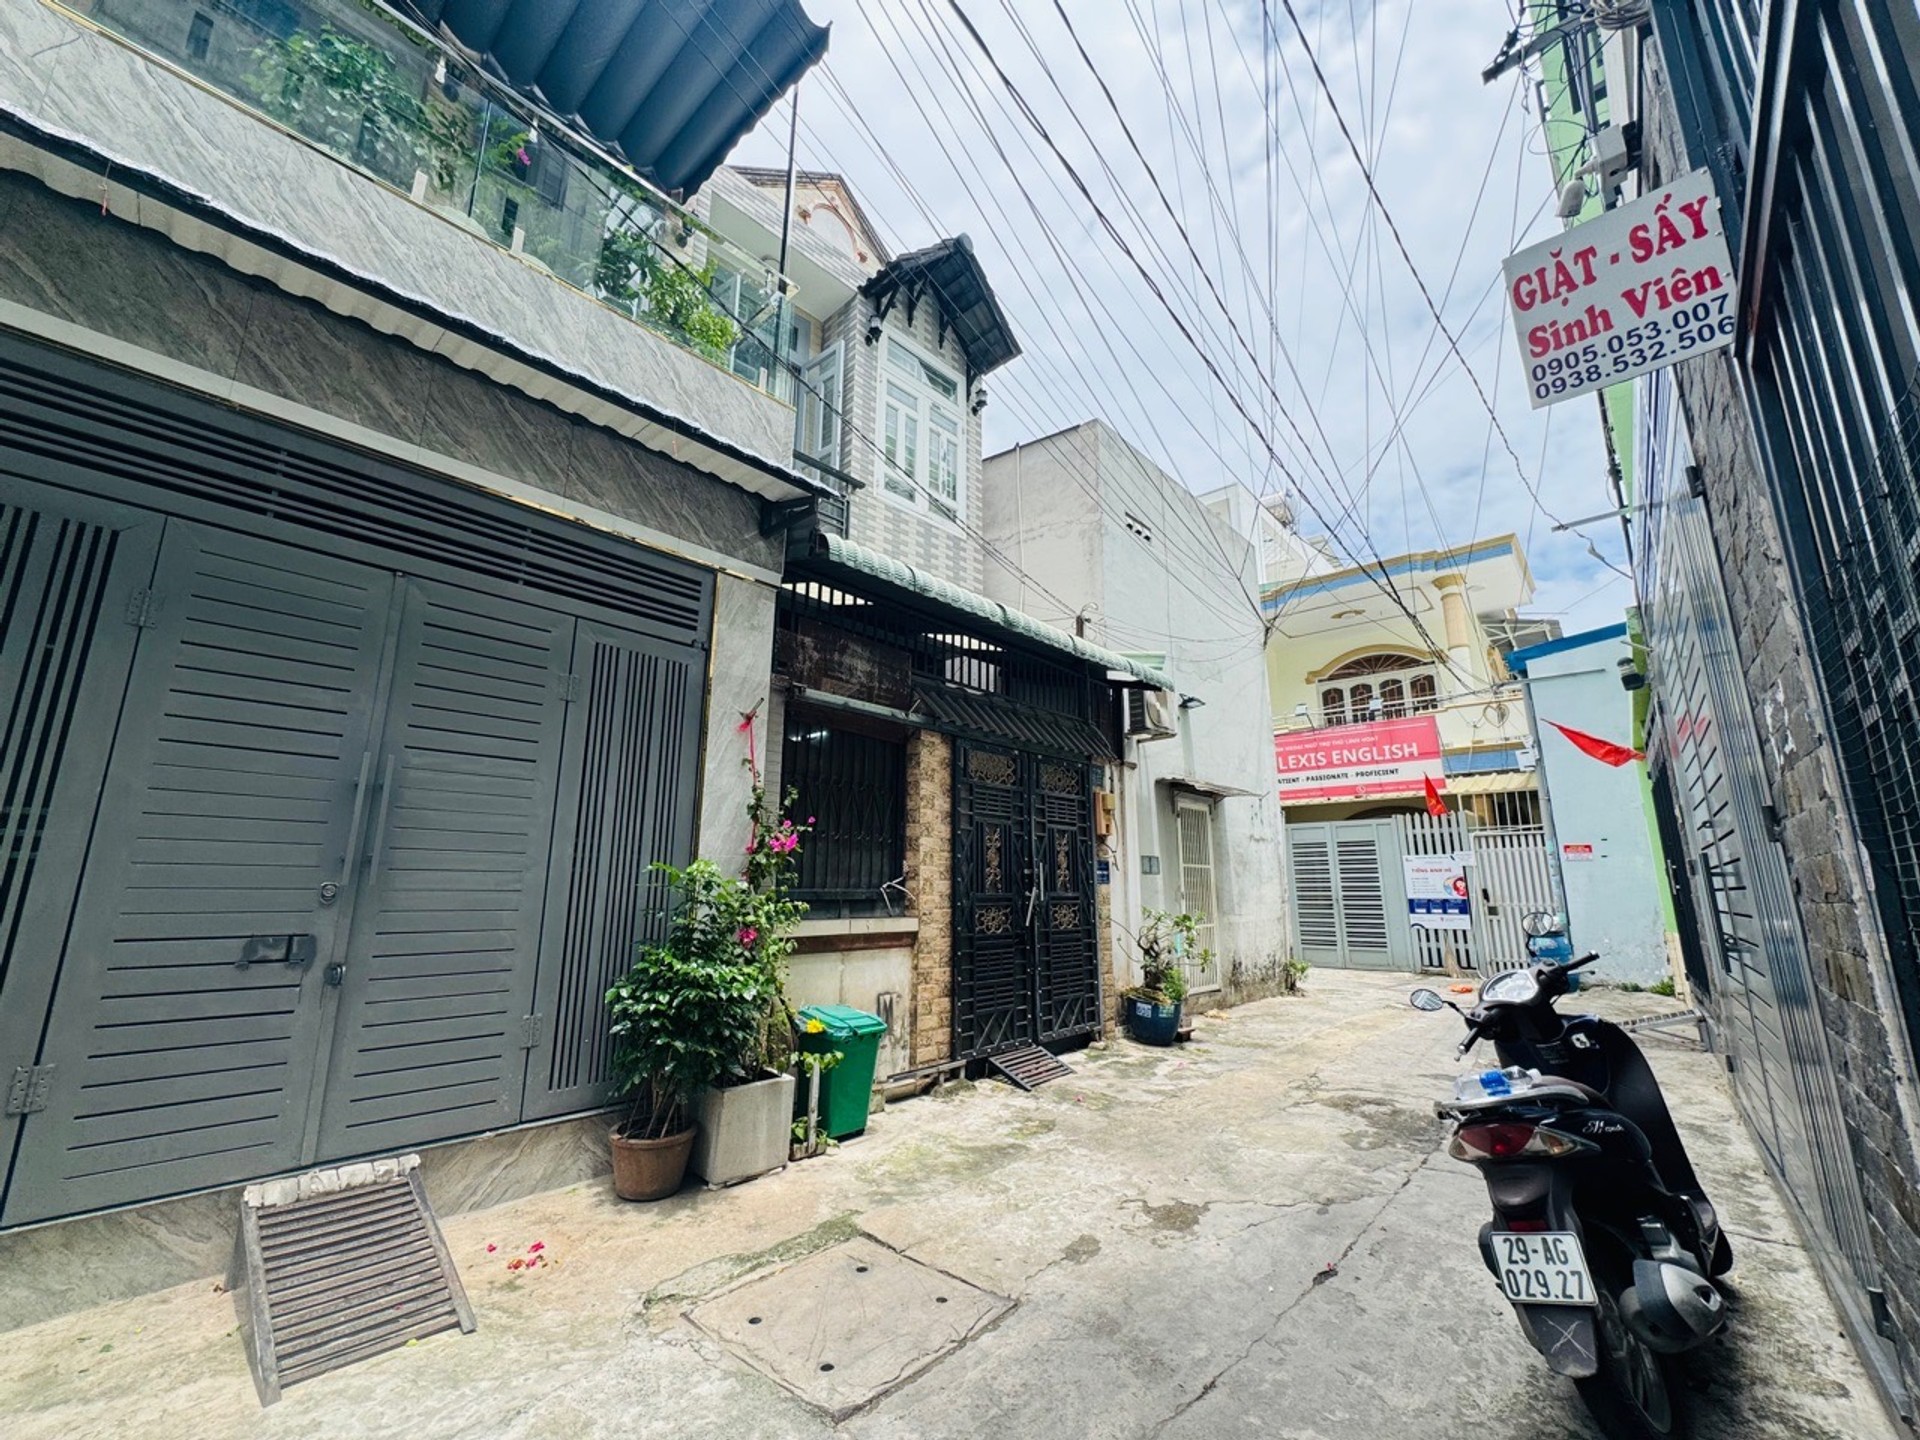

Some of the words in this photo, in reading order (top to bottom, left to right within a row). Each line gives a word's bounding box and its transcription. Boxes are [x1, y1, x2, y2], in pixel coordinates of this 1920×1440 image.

[1512, 245, 1598, 312] GIẶT
[1628, 192, 1709, 264] SẤY
[1527, 304, 1614, 358] Sinh
[1620, 265, 1724, 319] Viên
[1531, 292, 1730, 382] 0905.053.007
[1535, 315, 1736, 400] 0938.532.506
[1278, 752, 1326, 770] LEXIS
[1332, 742, 1419, 764] ENGLISH
[1306, 772, 1349, 783] PASSIONATE
[1355, 768, 1399, 778] PROFICIENT
[1503, 1237, 1569, 1266] 29-AG
[1505, 1269, 1585, 1300] 029.27
